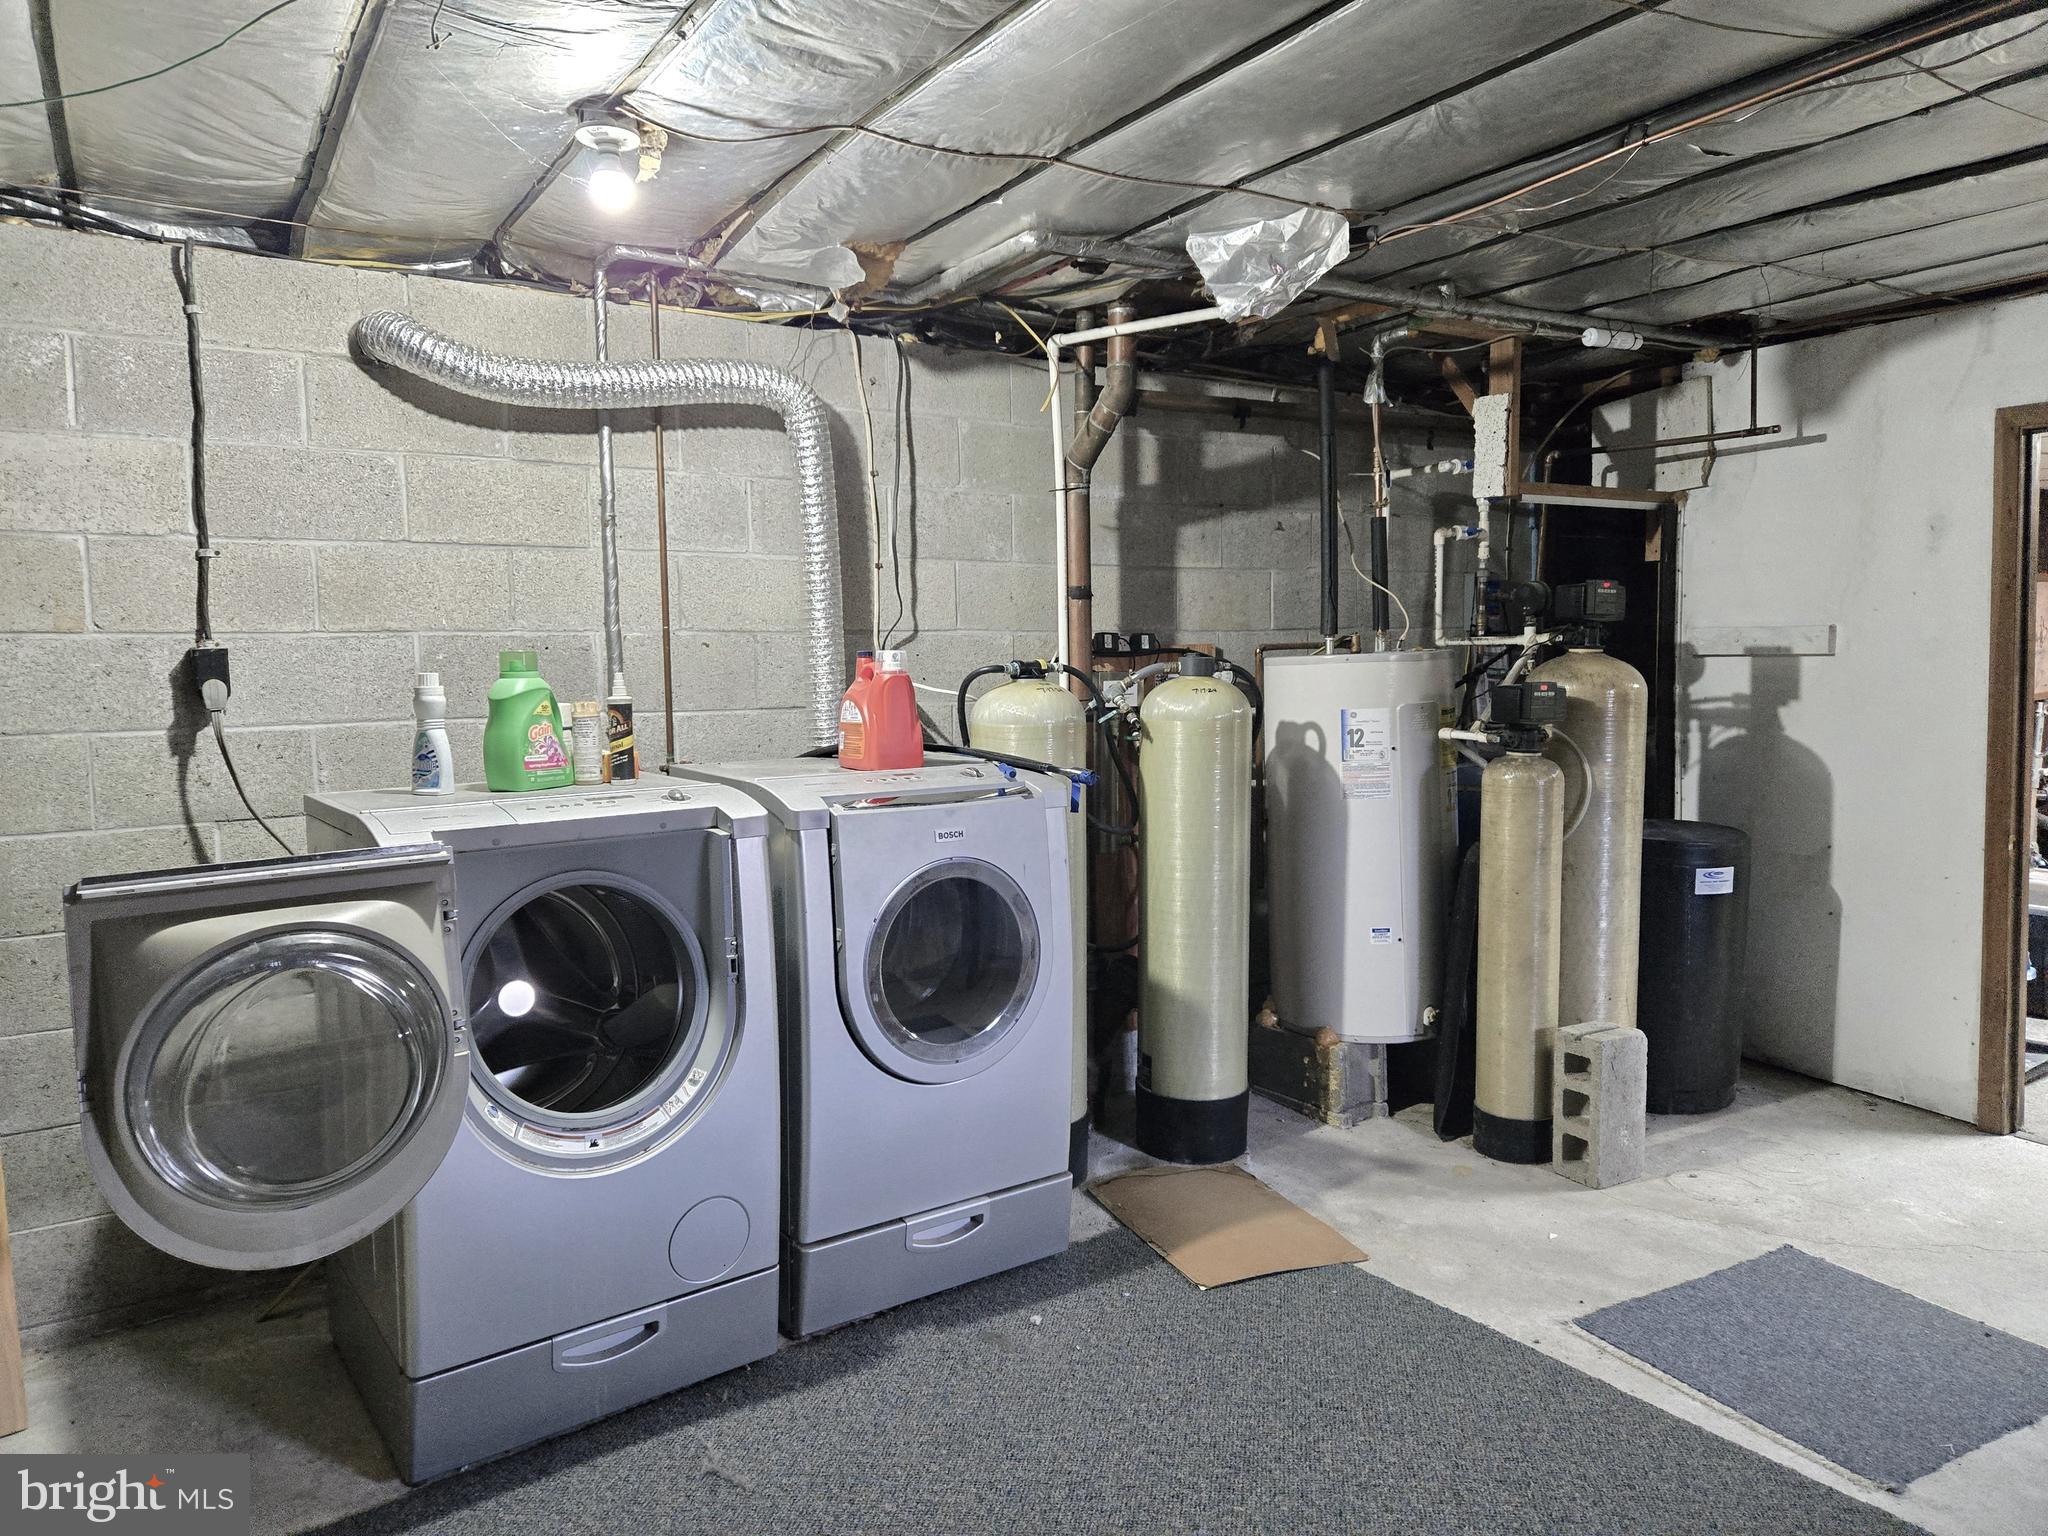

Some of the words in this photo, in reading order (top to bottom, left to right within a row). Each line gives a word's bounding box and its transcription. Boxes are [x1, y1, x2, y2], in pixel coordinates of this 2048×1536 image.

[528, 723, 552, 741] Gain
[616, 723, 629, 733] ALL
[1347, 728, 1365, 748] 12
[938, 830, 964, 840] BOSCH
